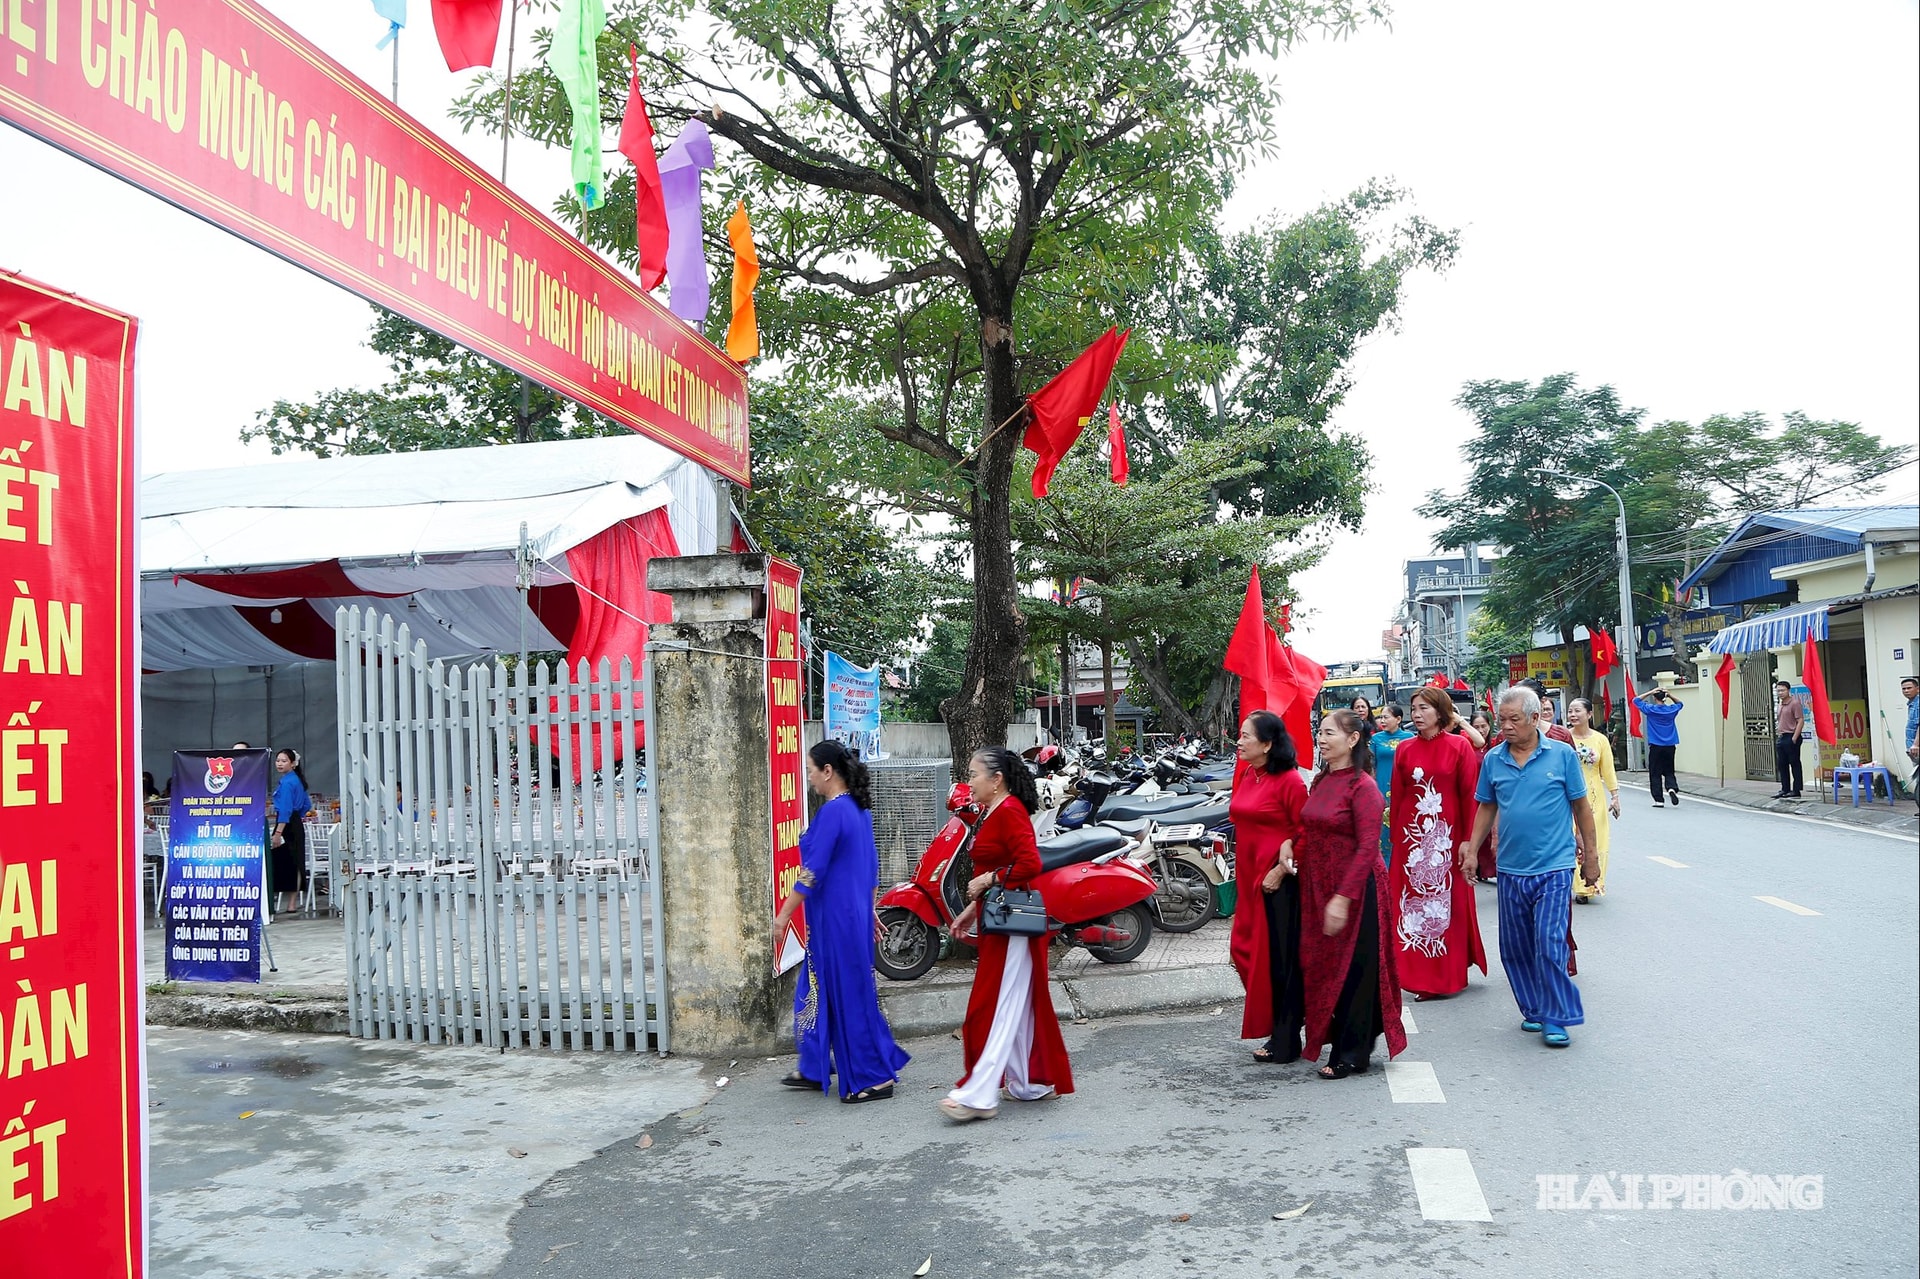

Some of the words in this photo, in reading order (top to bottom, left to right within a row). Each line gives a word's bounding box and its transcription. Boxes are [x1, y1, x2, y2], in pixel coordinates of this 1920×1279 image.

[81, 0, 188, 134] CHÀO
[199, 48, 295, 197] MỪNG
[304, 113, 356, 230] CÁC
[365, 155, 387, 267] VỊ
[393, 175, 430, 286] ĐẠI
[436, 189, 481, 301] BIỂU
[486, 220, 508, 316] VỀ
[512, 252, 537, 346] DỰ
[538, 270, 579, 355] NGÀY
[582, 293, 604, 383] HỘI
[607, 316, 628, 396] ĐẠI
[631, 330, 662, 405] ĐOÀN
[664, 341, 683, 417] KẾT
[684, 364, 708, 433] TOÀN
[710, 379, 727, 443] DÂN
[728, 392, 744, 461] TỘC
[0, 440, 60, 545] ẾT
[772, 578, 796, 614] THÀNH
[772, 672, 798, 706] THÀNH
[777, 720, 798, 754] CÔNG
[1831, 704, 1864, 739] HÁO
[2, 702, 69, 807] ẾT
[781, 772, 796, 807] ĐẠI
[197, 821, 210, 838] HỖ
[212, 824, 232, 840] TRỢ
[173, 843, 190, 859] CÁN
[192, 844, 204, 861] BỘ
[206, 842, 233, 858] ĐẢNG
[236, 843, 259, 858] VIÊN
[182, 863, 193, 879] VÀ
[195, 863, 221, 879] NHÂN
[224, 863, 245, 879] DÂN
[171, 884, 187, 899] GÓP
[188, 883, 194, 899] Ý
[196, 884, 214, 899] VÀO
[216, 885, 232, 902] DỰ
[232, 882, 259, 900] THẢO
[172, 903, 189, 920] CÁC
[190, 903, 209, 920] VĂN
[211, 904, 235, 923] KIỆN
[236, 907, 255, 920] XIV
[175, 922, 192, 940] CỦA
[193, 923, 220, 940] ĐẢNG
[221, 925, 248, 941] TRÊN
[172, 944, 191, 960] ỨNG
[192, 947, 217, 964] DỤNG
[219, 948, 250, 962] VNIED
[0, 978, 89, 1079] ÀN
[0, 1100, 67, 1221] ẾT
